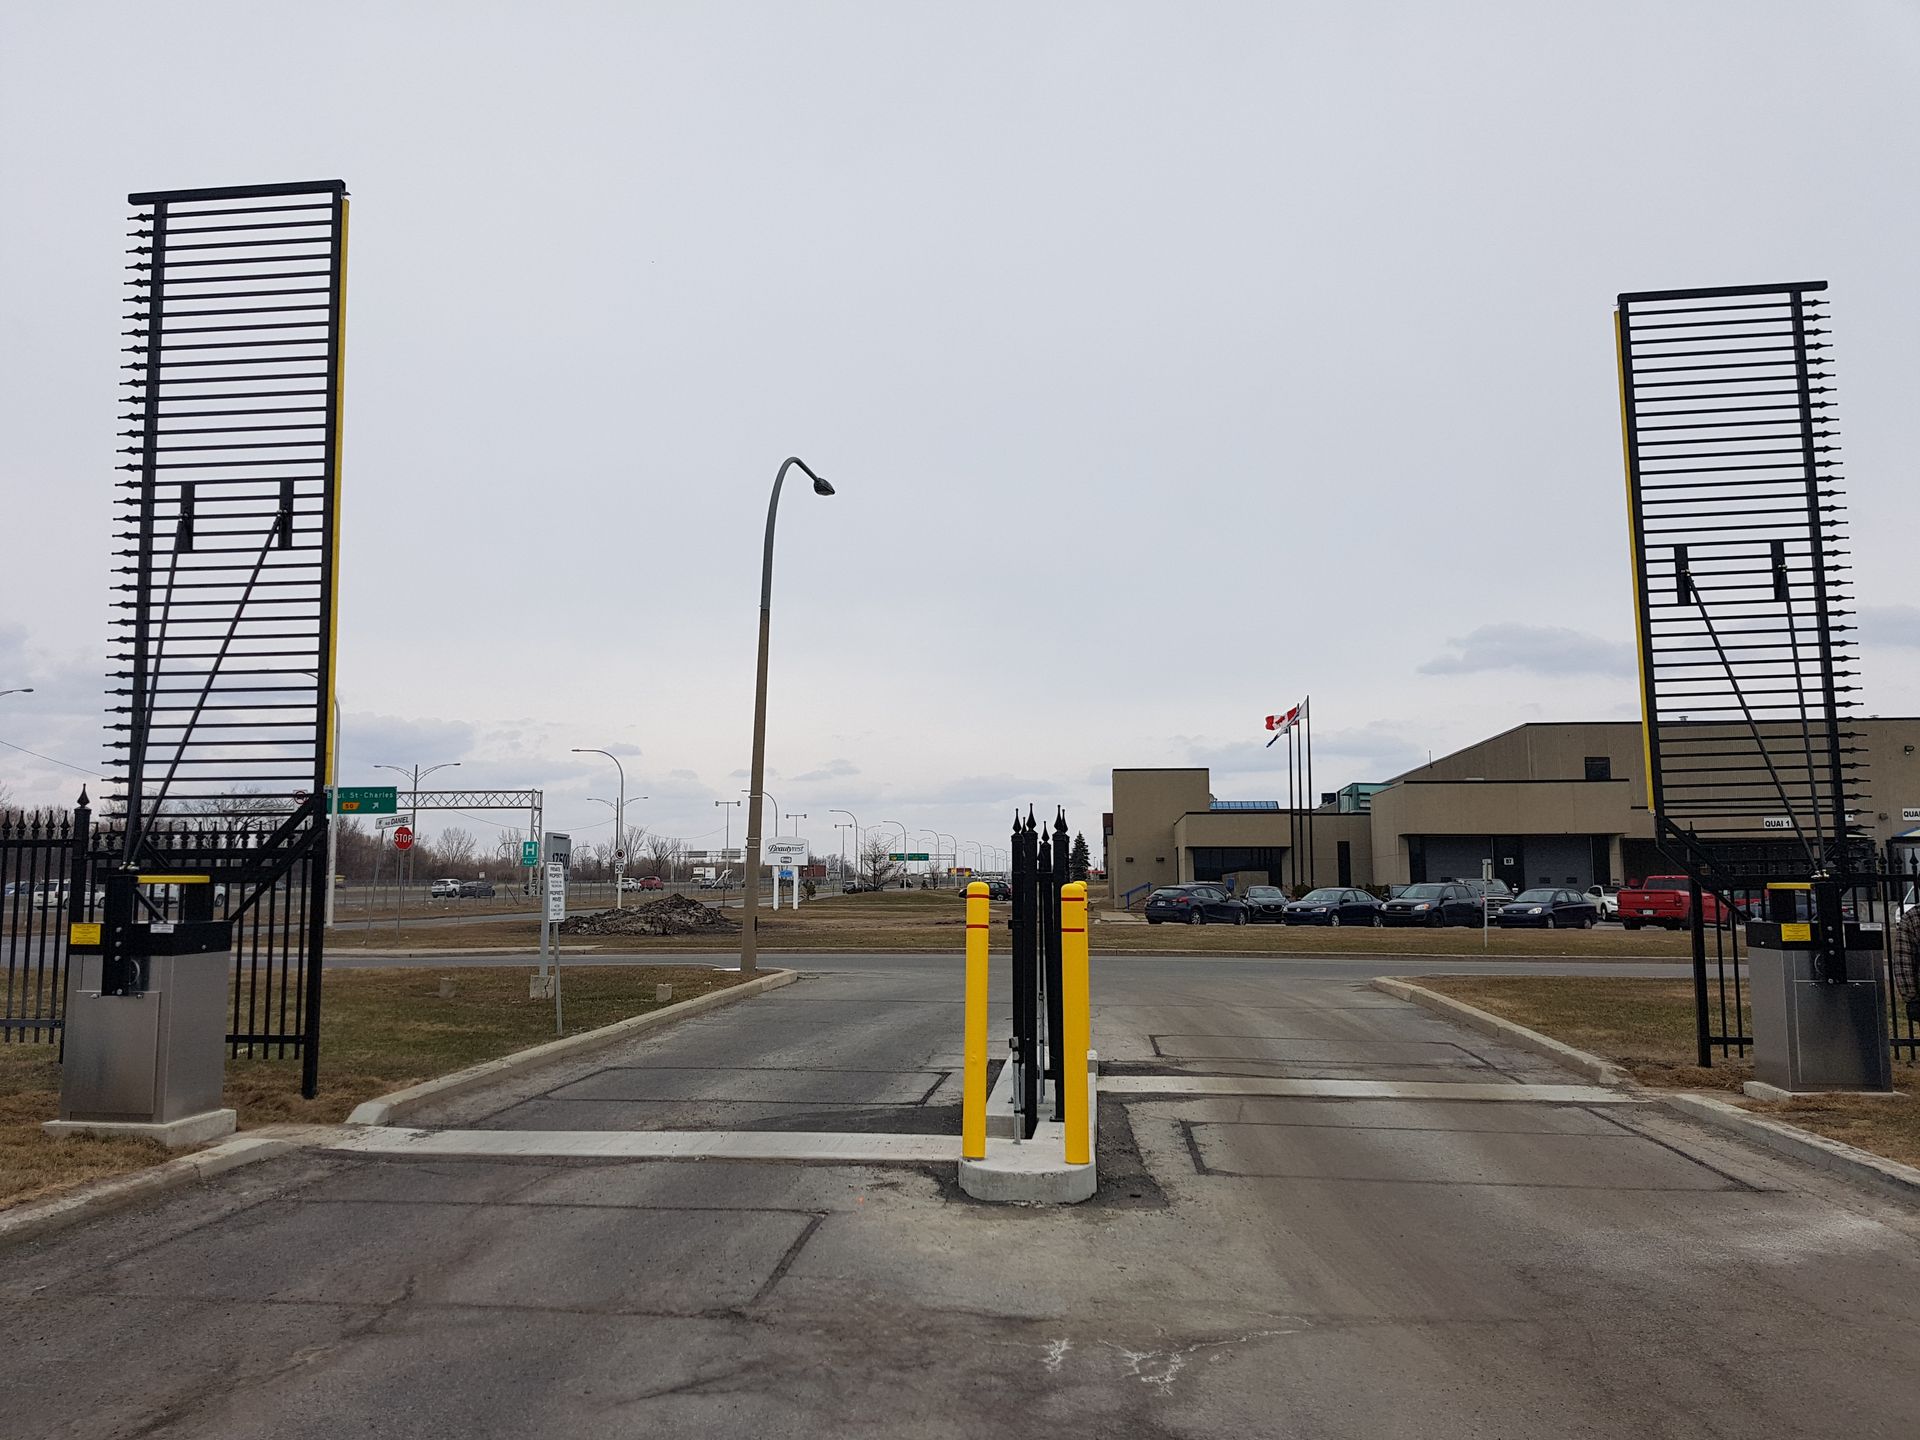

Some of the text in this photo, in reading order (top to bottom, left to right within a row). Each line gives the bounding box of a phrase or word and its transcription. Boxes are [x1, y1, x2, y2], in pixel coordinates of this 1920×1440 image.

[1765, 820, 1784, 828] QUAI
[394, 833, 413, 843] STOP
[525, 843, 535, 856] H
[615, 864, 624, 872] 50
